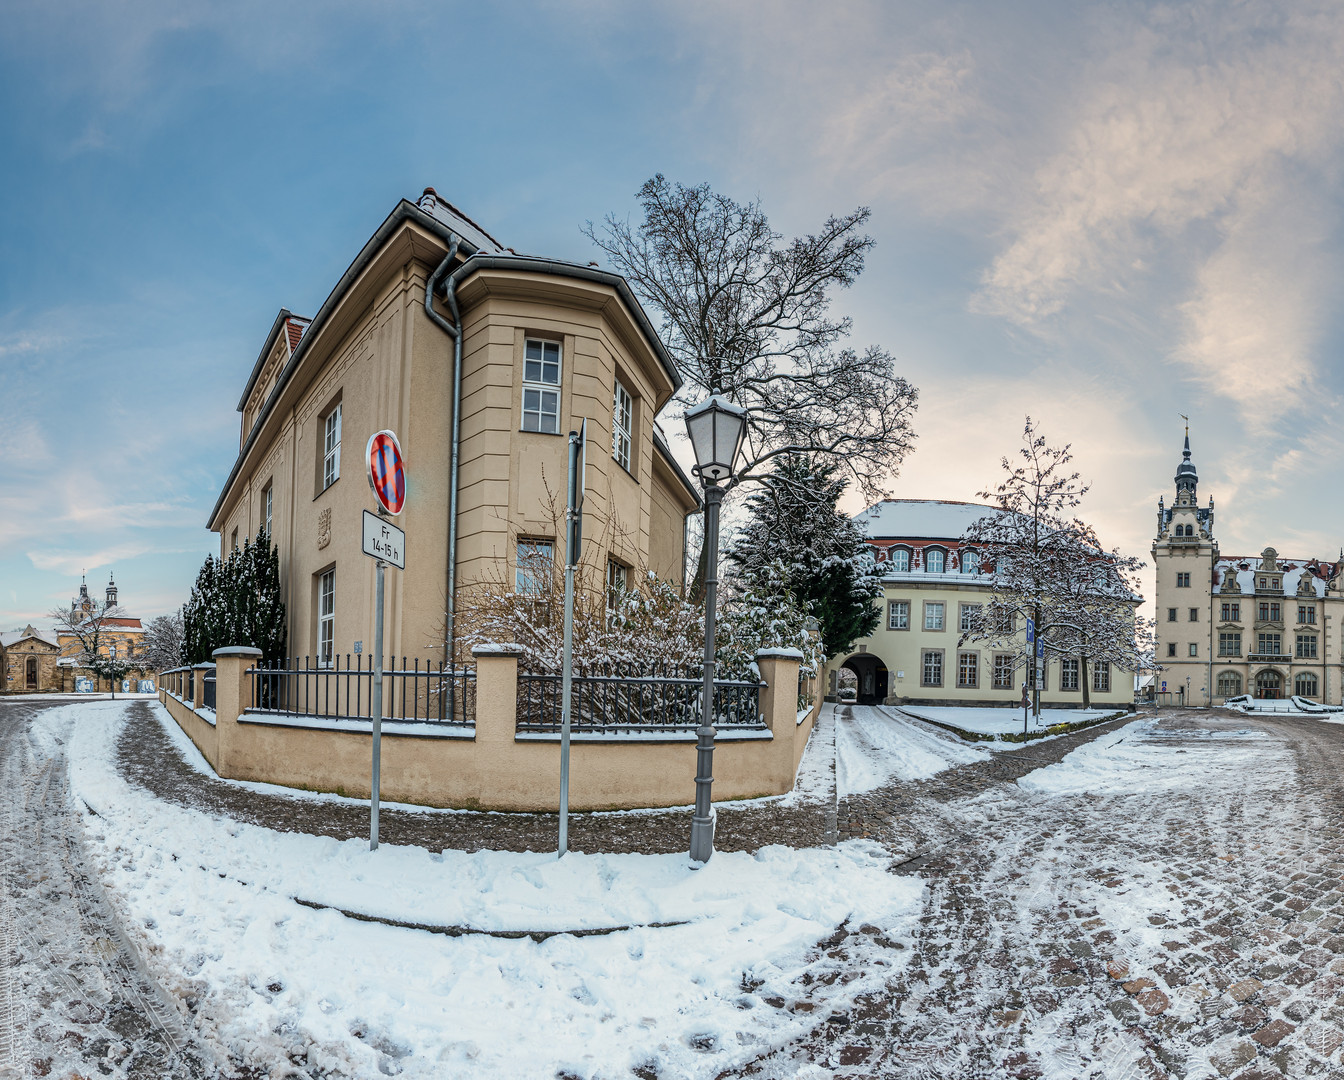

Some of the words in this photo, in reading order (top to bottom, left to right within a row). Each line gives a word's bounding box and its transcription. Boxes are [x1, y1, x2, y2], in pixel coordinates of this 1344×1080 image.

[382, 526, 390, 540] Fr
[372, 538, 392, 557] 14-15
[394, 547, 399, 560] h
